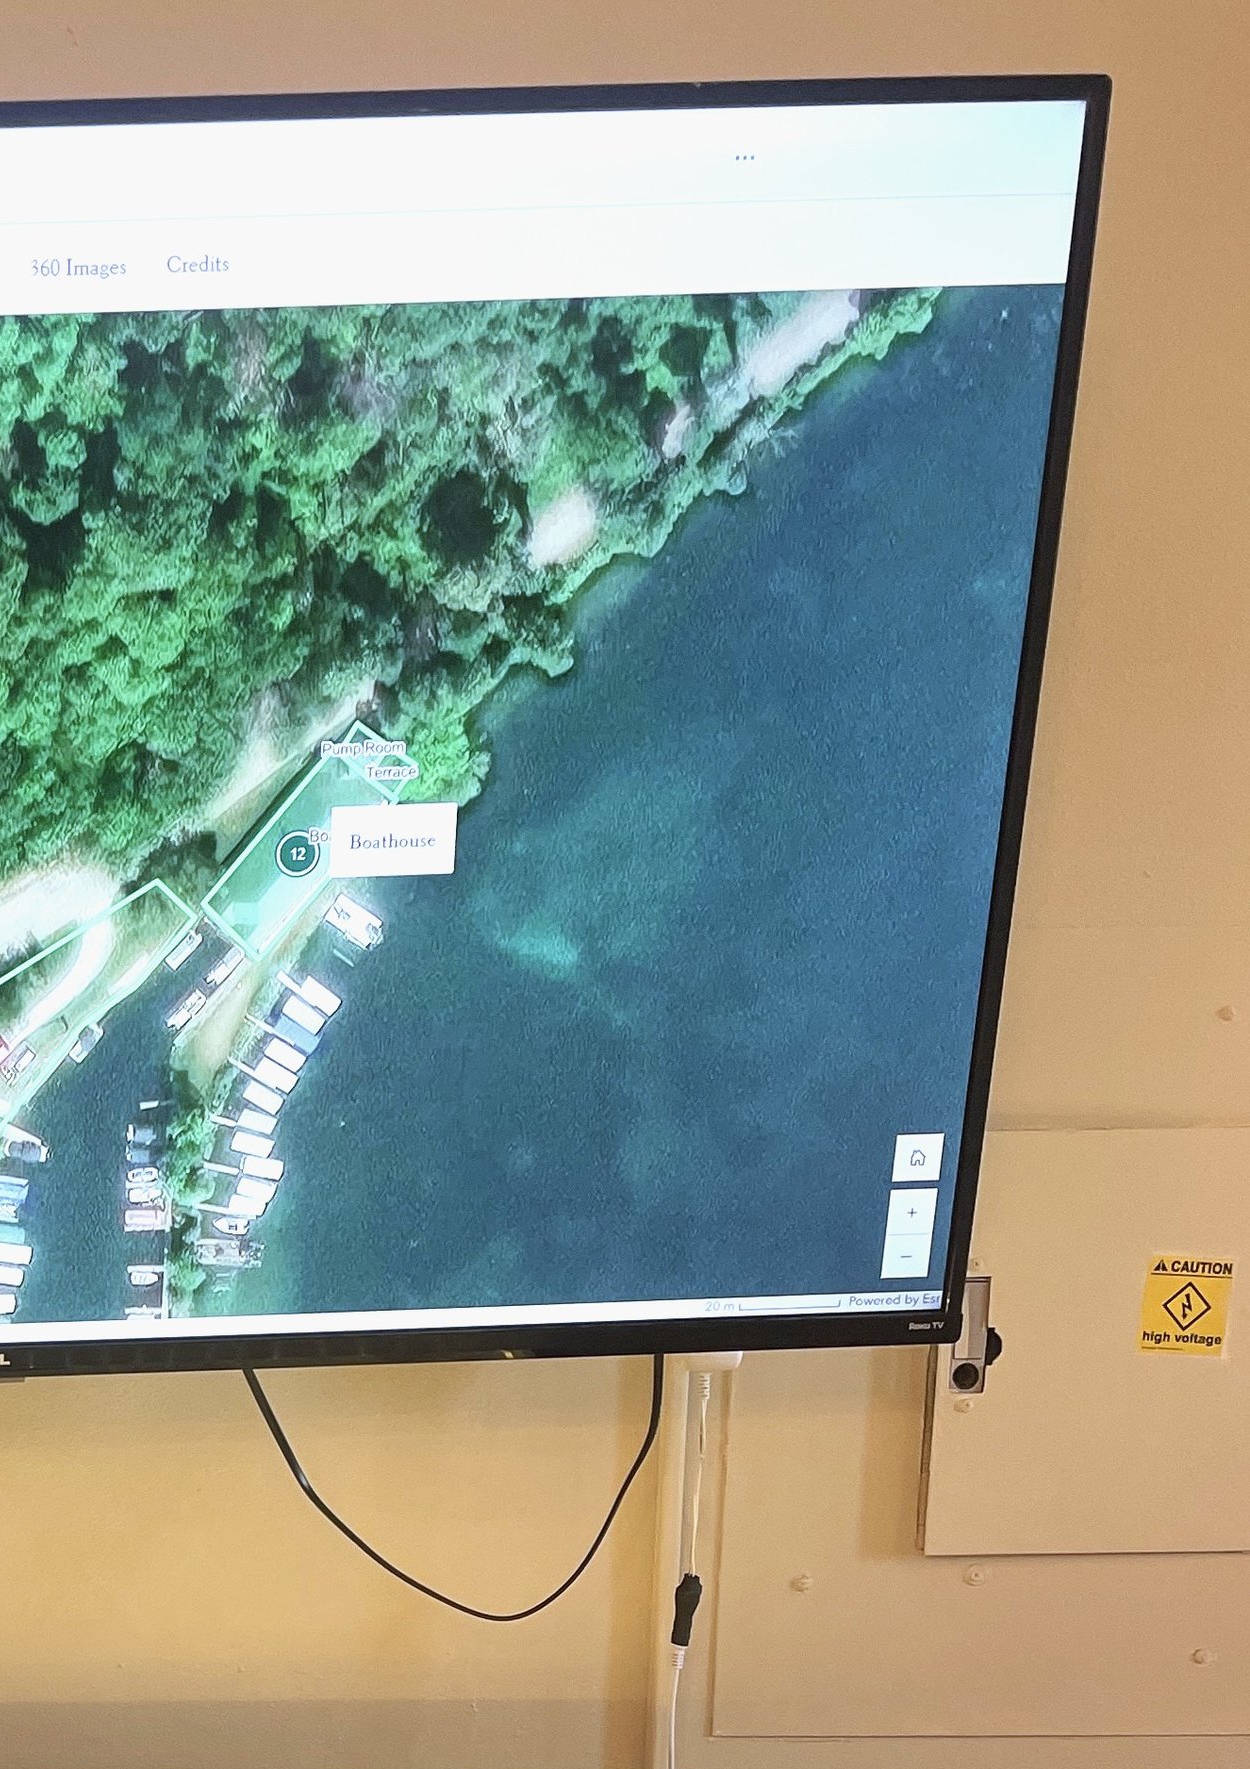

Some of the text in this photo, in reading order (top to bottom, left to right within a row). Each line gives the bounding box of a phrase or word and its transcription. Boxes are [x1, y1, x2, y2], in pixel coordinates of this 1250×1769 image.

[31, 258, 126, 279] 360 Images
[167, 254, 229, 273] Credits
[323, 742, 404, 756] Pump Room
[367, 766, 417, 778] Terrace
[350, 833, 436, 850] Boathouse
[290, 847, 306, 861] 12
[1171, 1260, 1233, 1275] CAUTION
[705, 1302, 721, 1311] 20
[849, 1294, 941, 1307] Powered by Esr
[1142, 1331, 1222, 1347] high voltage
